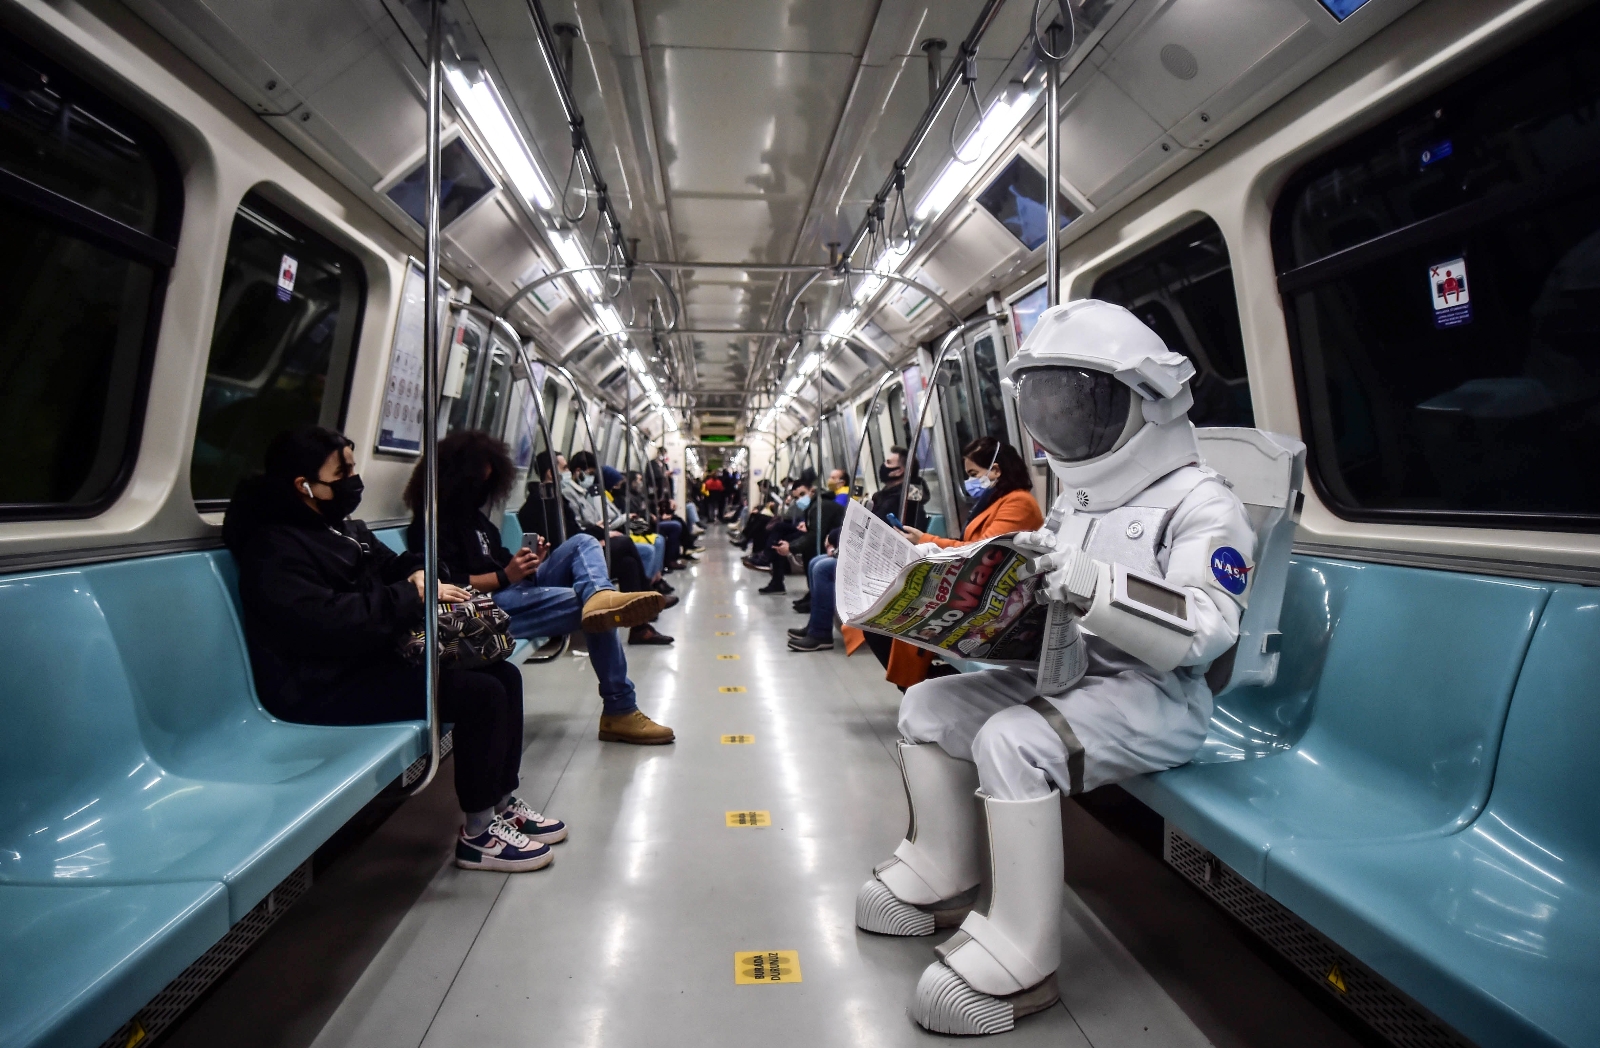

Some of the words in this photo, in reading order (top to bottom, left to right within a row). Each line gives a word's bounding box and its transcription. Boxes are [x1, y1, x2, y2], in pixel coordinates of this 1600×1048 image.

[1214, 558, 1246, 584] NASA
[754, 955, 765, 979] BURADA
[769, 953, 781, 980] DURUNUZ
